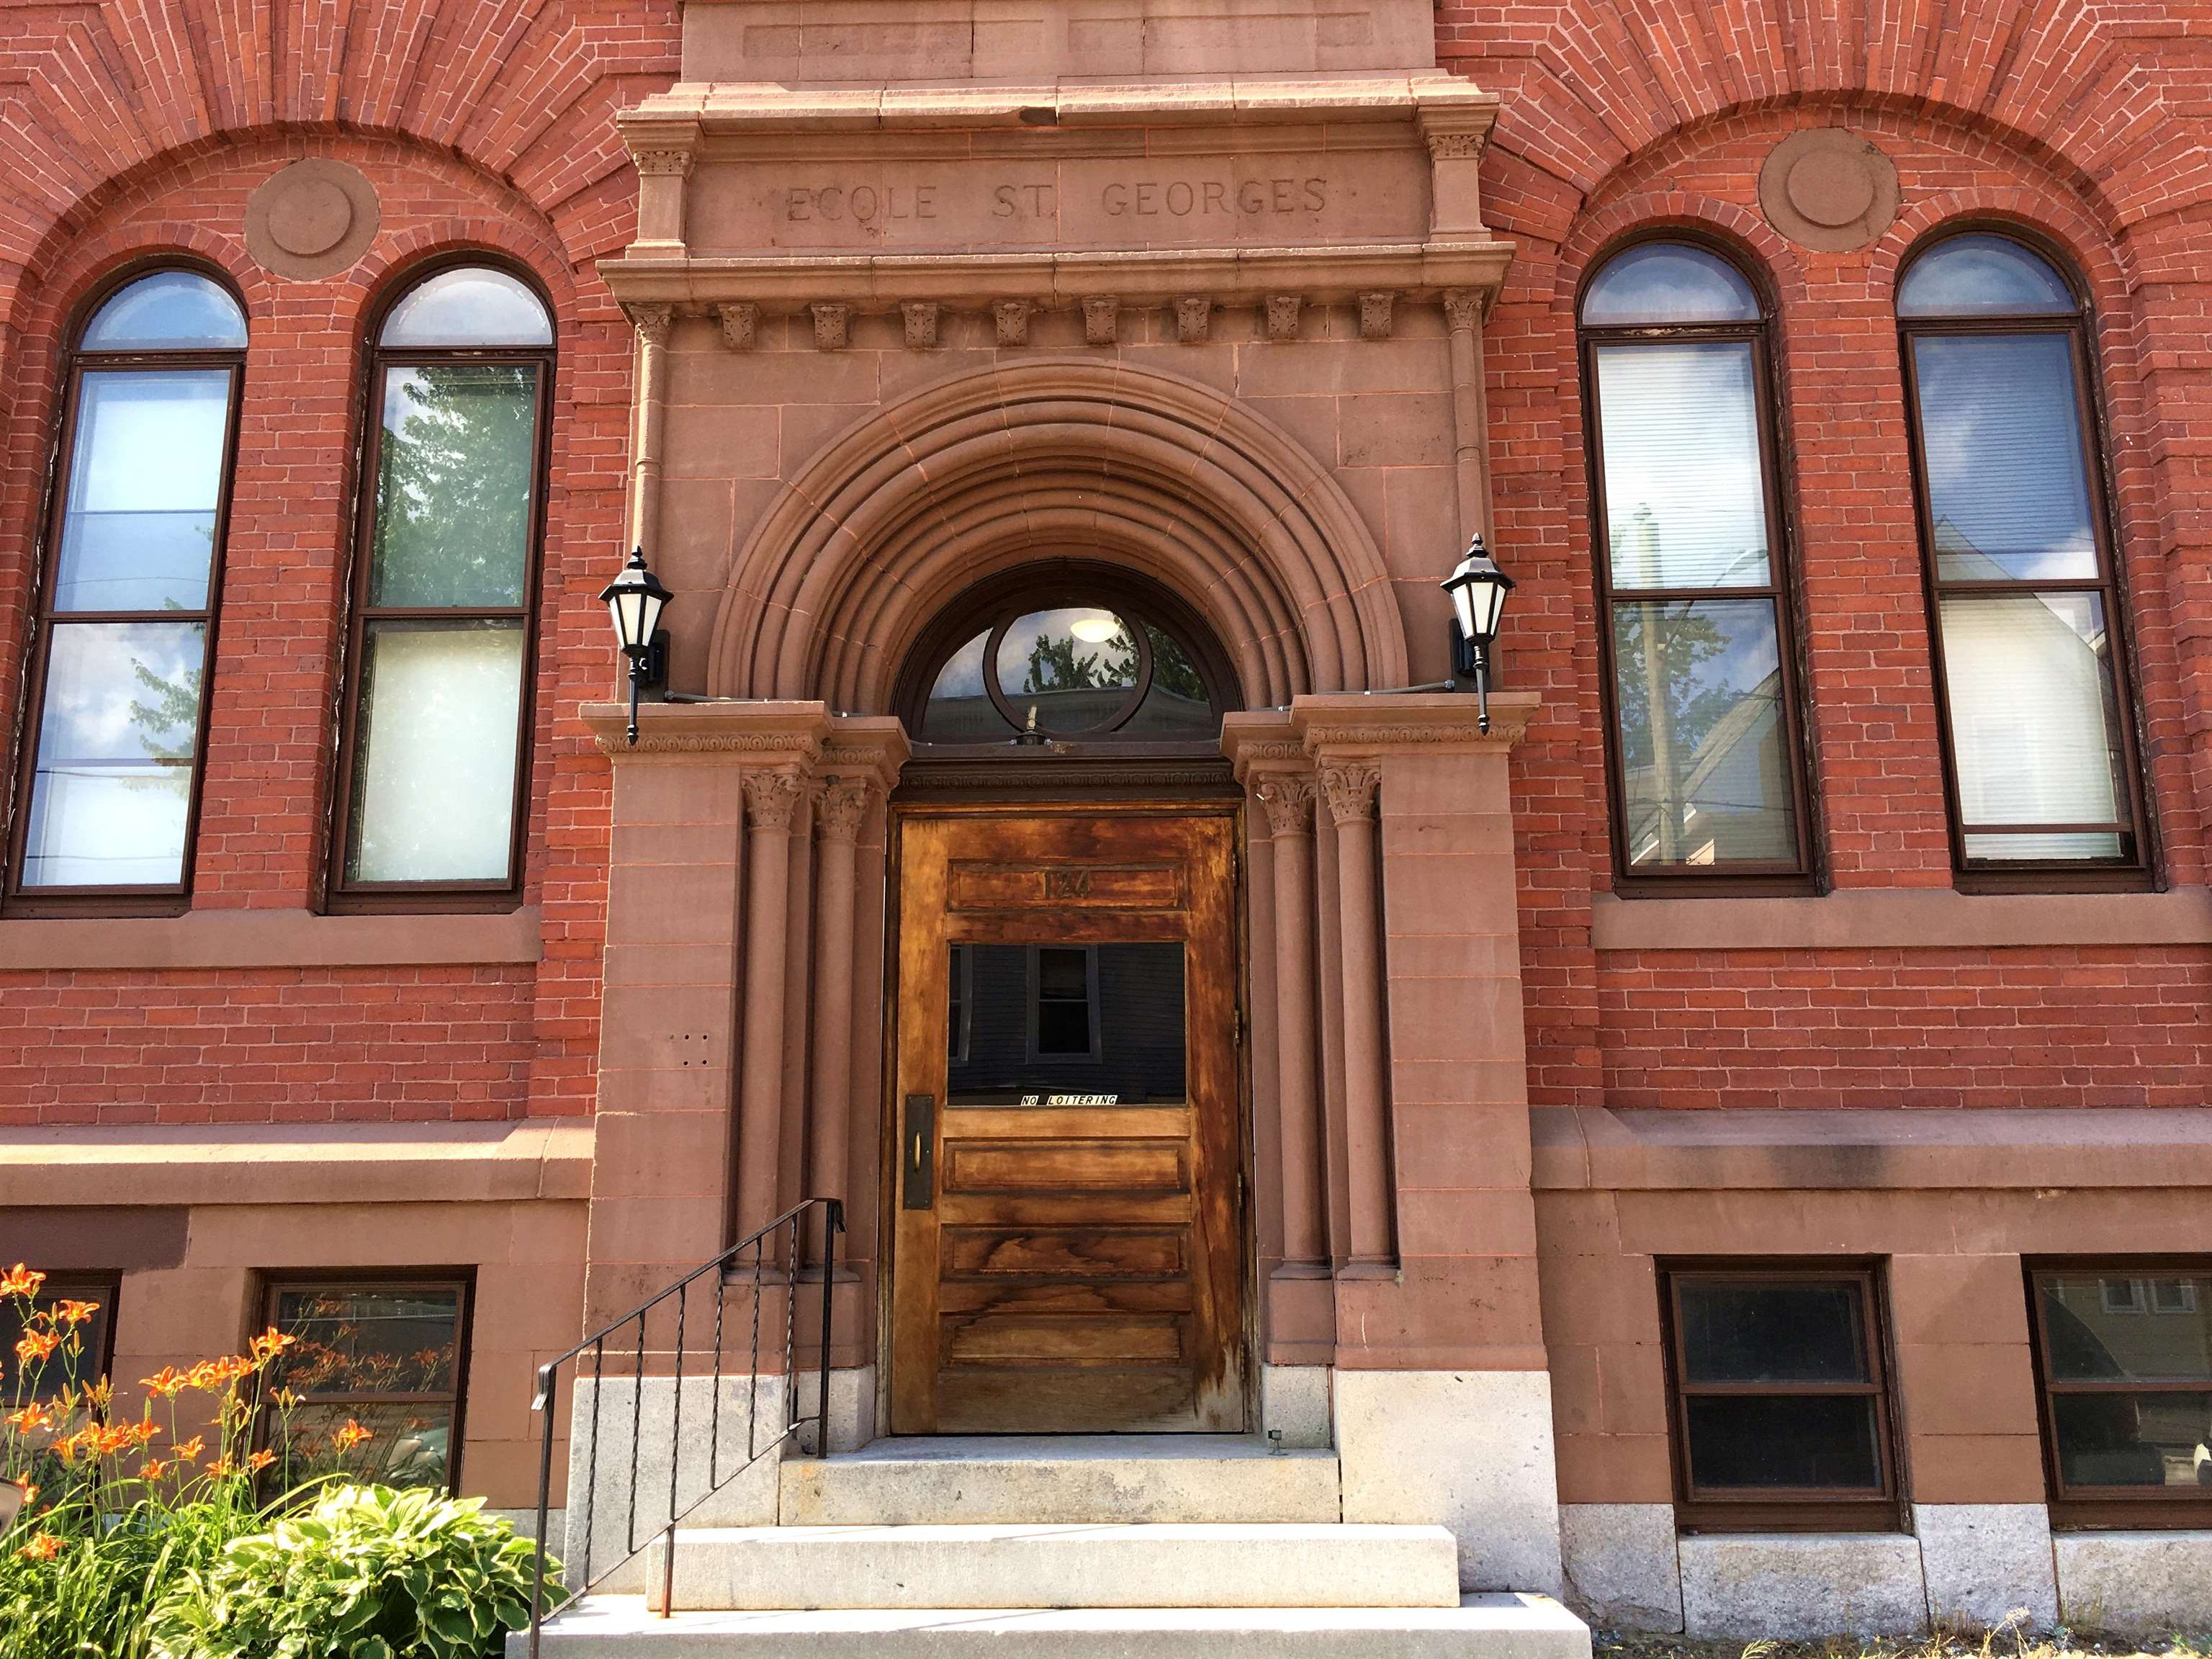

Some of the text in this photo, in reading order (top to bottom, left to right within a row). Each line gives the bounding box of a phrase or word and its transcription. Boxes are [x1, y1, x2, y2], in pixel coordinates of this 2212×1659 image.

[787, 185, 938, 221] ECOLE
[1101, 177, 1327, 216] GEORGES
[1021, 1095, 1116, 1105] NO LOITERING
